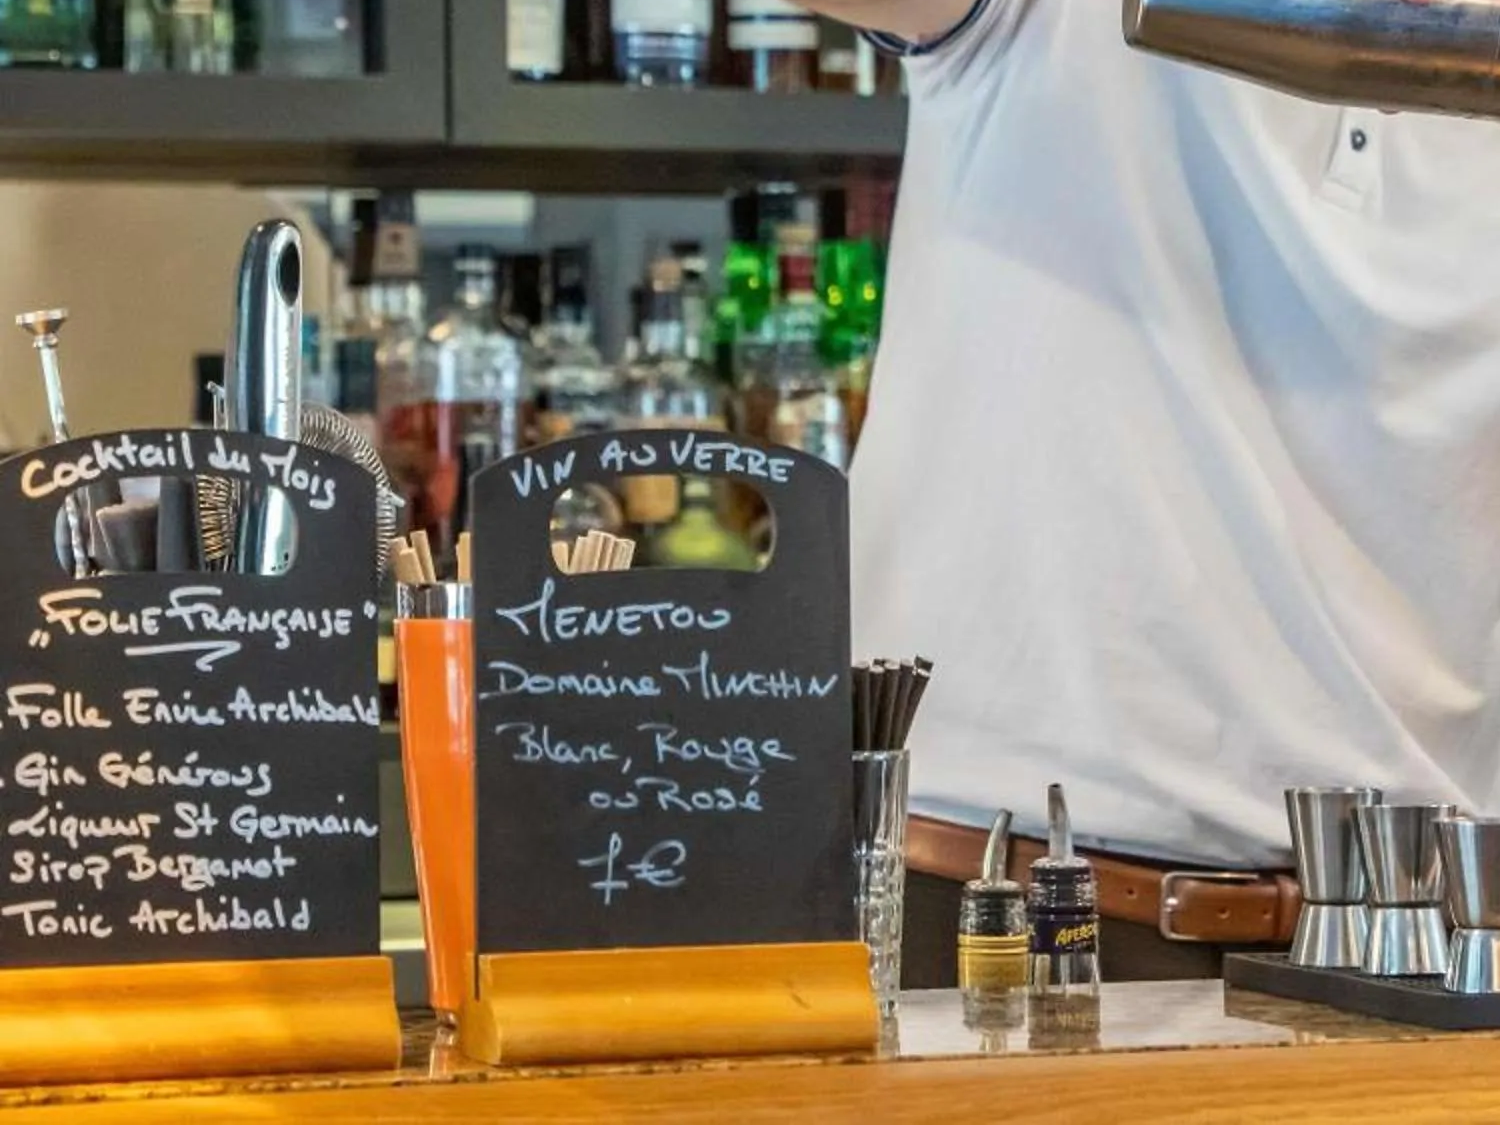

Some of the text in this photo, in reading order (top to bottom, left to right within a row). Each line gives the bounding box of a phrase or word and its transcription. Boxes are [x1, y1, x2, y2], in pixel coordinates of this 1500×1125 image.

[21, 431, 336, 510] Cocktail du Mois
[511, 433, 794, 498] VIN AU VERRE
[479, 661, 661, 698] Domaine
[7, 684, 379, 729] Folle Envie Archibald
[638, 722, 796, 773] Rouge
[15, 753, 86, 796] Gin
[589, 776, 763, 812] ou Rosé
[8, 795, 378, 849] Liqueur St Germain
[10, 844, 296, 891] Sirop Bergamot
[2, 896, 309, 938] Tonic Archibald
